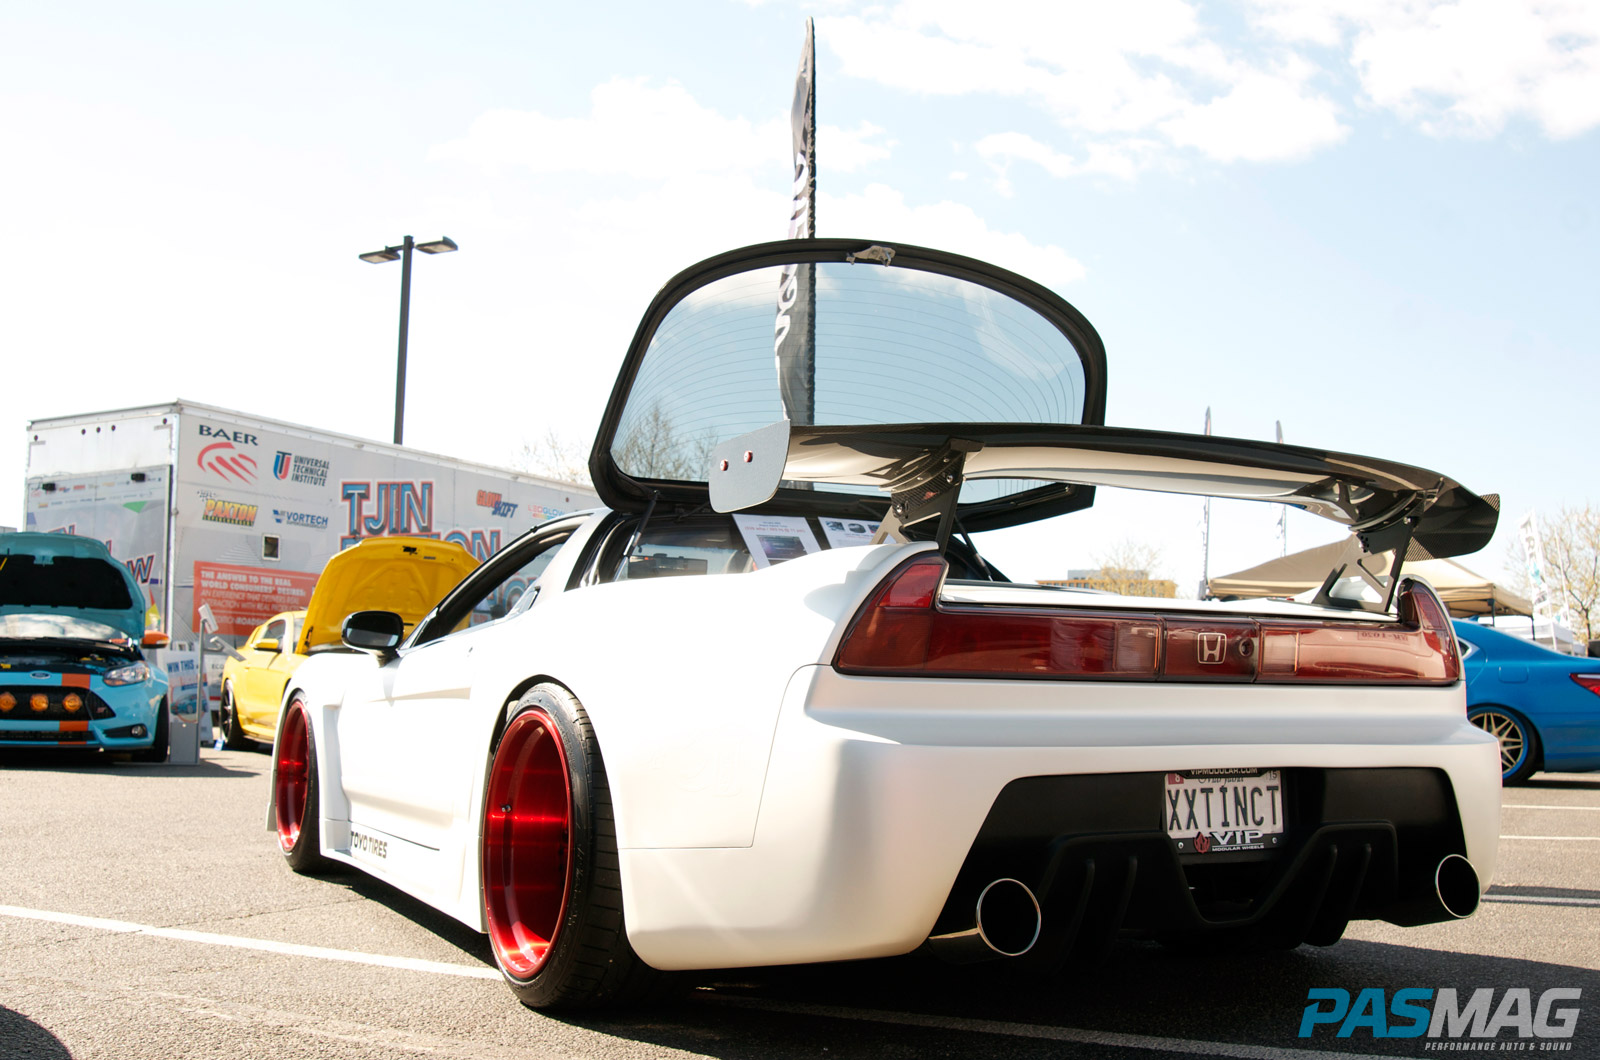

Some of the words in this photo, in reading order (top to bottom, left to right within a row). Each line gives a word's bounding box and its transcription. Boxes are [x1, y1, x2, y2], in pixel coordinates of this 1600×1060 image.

[199, 424, 258, 446] BAER
[294, 455, 330, 470] UNIVERSAL
[292, 464, 328, 478] TECHNICAL
[291, 473, 326, 487] INSTITUTE
[204, 498, 258, 522] PAXTON
[341, 481, 433, 536] TJIN
[286, 511, 329, 526] VORTECH
[201, 570, 214, 579] THE
[216, 572, 247, 582] ANSWER
[249, 575, 259, 583] TO
[260, 576, 273, 586] THE
[275, 578, 292, 587] REAL
[201, 580, 228, 590] WORLD
[167, 662, 179, 673] WIN
[181, 659, 194, 671] THIS
[1190, 768, 1258, 776] VIPMODULAR.COM
[1167, 786, 1279, 831] XXTINCT
[350, 831, 367, 851] TOYO
[369, 837, 388, 859] TIRES
[1211, 830, 1264, 845] VIP
